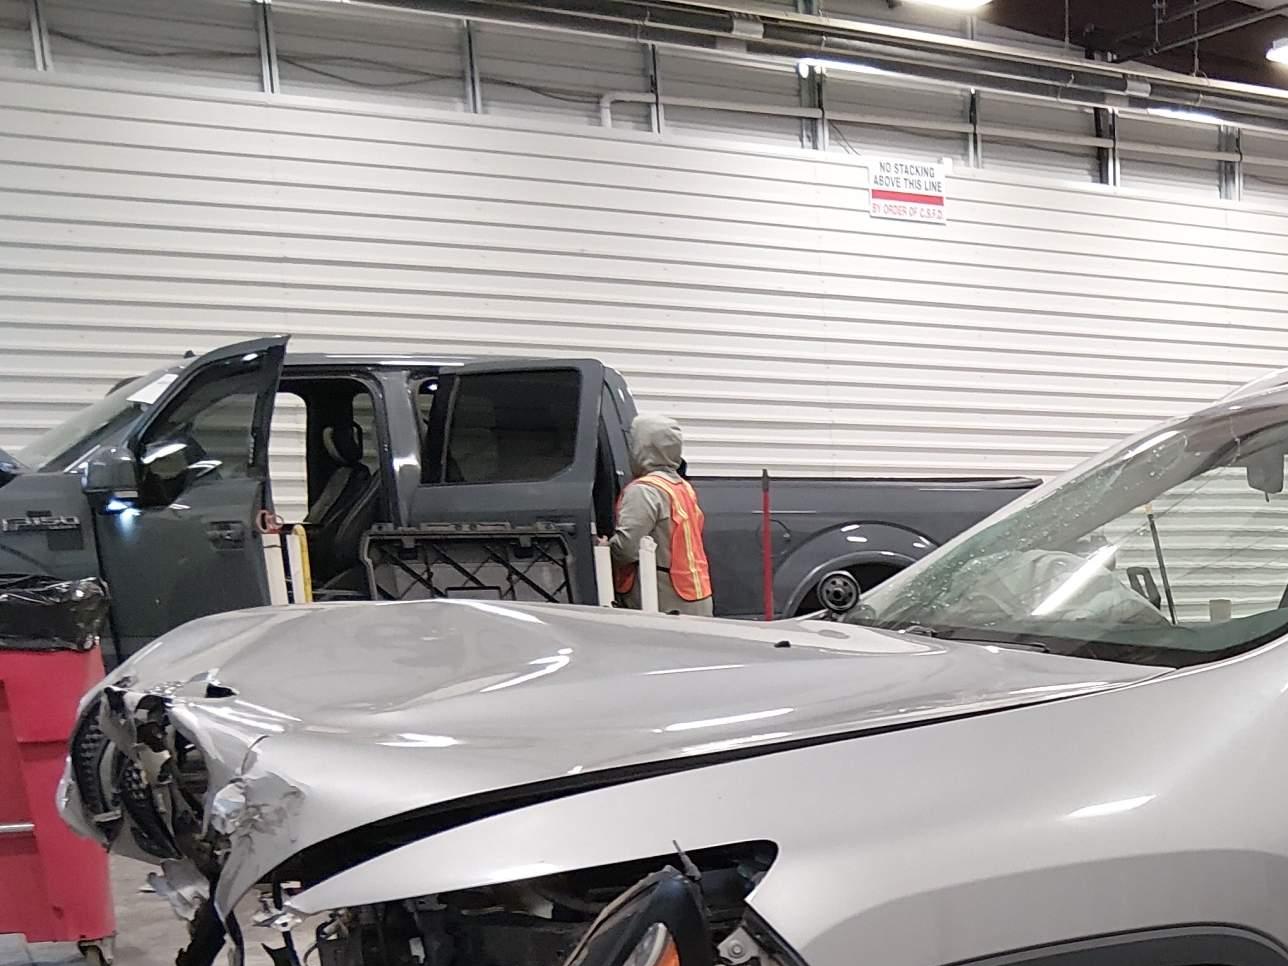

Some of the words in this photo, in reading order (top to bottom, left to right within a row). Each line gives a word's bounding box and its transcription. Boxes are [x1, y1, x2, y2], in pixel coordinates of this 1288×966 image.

[879, 161, 892, 174] NO
[894, 162, 935, 178] STACKING
[873, 174, 901, 188] ABOVE
[903, 177, 922, 191] THIS
[924, 180, 943, 193] LINE
